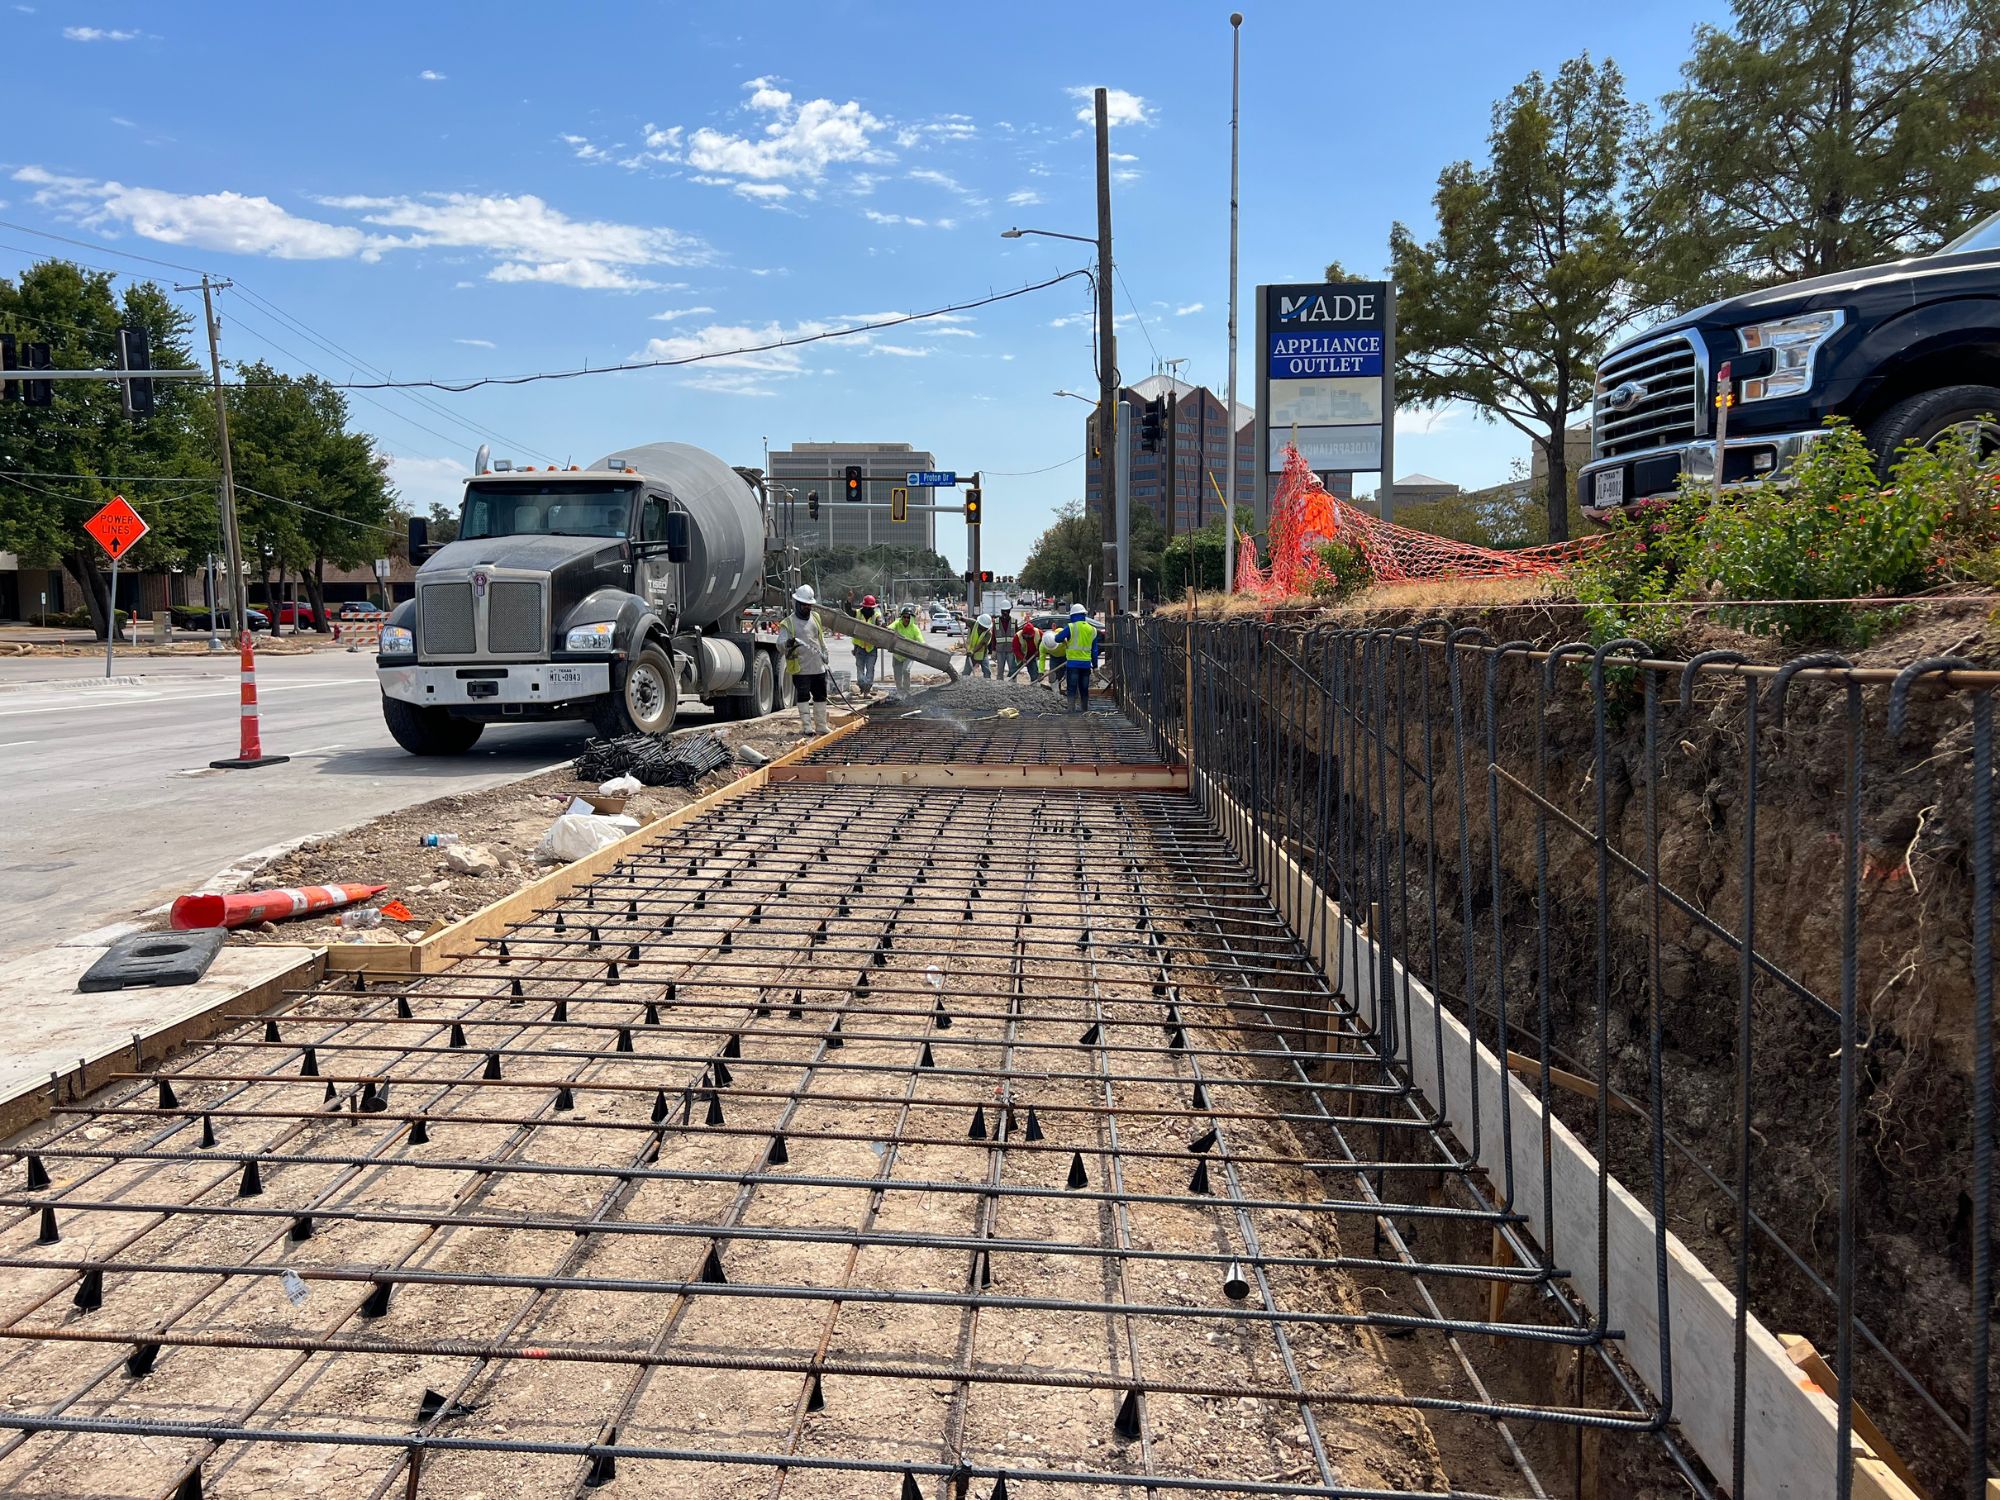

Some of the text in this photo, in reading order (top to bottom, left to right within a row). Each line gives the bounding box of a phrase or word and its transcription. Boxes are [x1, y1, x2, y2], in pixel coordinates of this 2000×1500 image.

[1280, 294, 1376, 323] MADE
[1273, 337, 1380, 354] APPLIANCE
[1289, 357, 1364, 373] OUTLET
[942, 473, 950, 482] Dr
[101, 514, 133, 524] POWER
[102, 525, 130, 535] LINES
